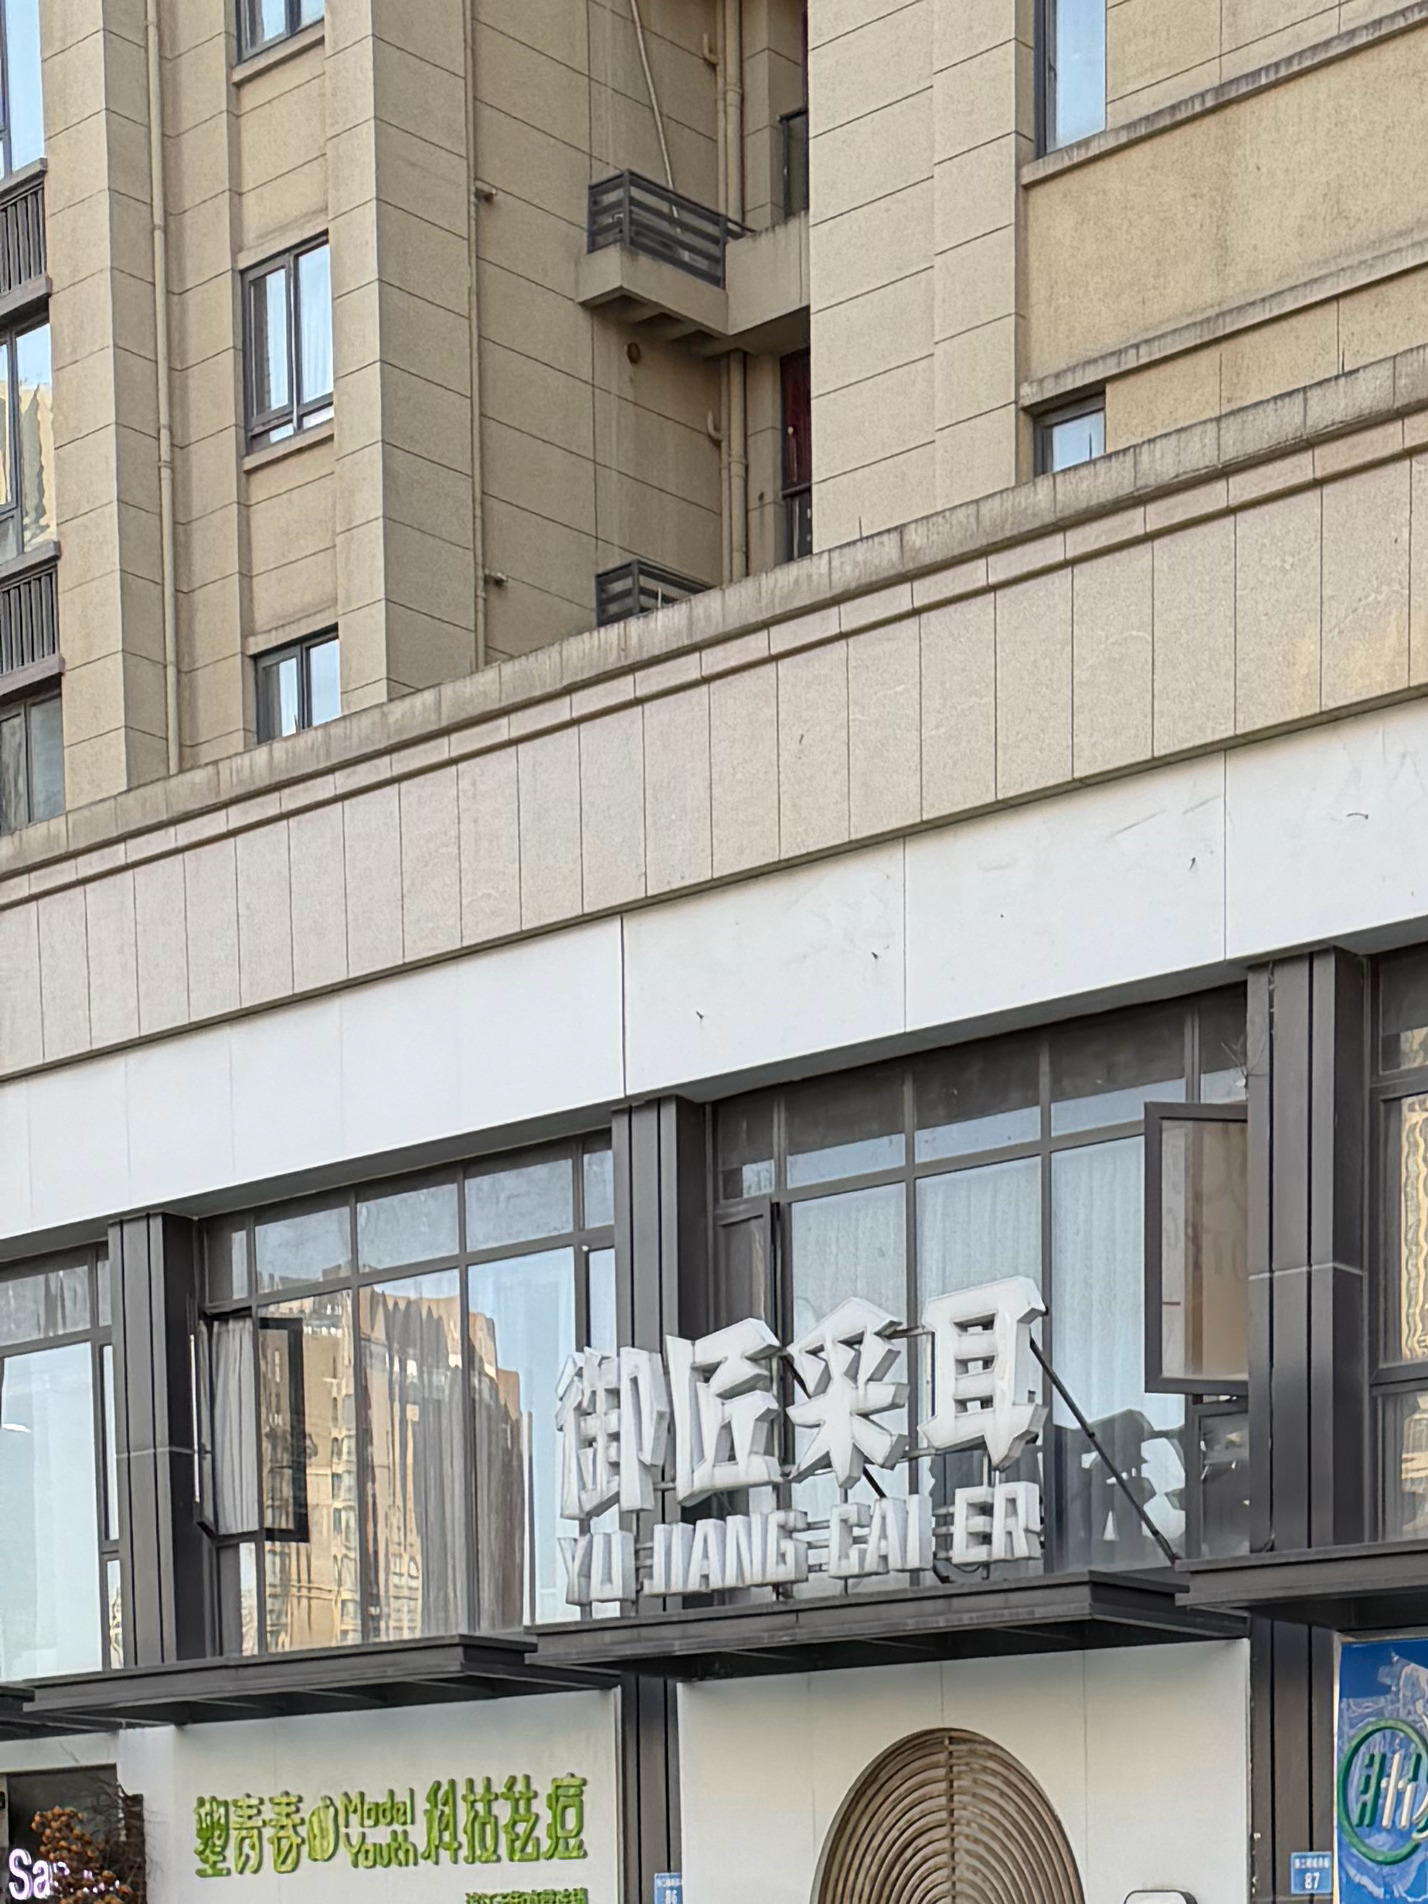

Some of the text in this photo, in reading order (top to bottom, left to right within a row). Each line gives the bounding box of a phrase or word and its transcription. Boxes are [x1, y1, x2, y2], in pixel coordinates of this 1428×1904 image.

[555, 1275, 1047, 1520] 御匠采耳
[558, 1481, 1041, 1604] YU JIANG CAI ER
[1304, 1872, 1320, 1890] 87
